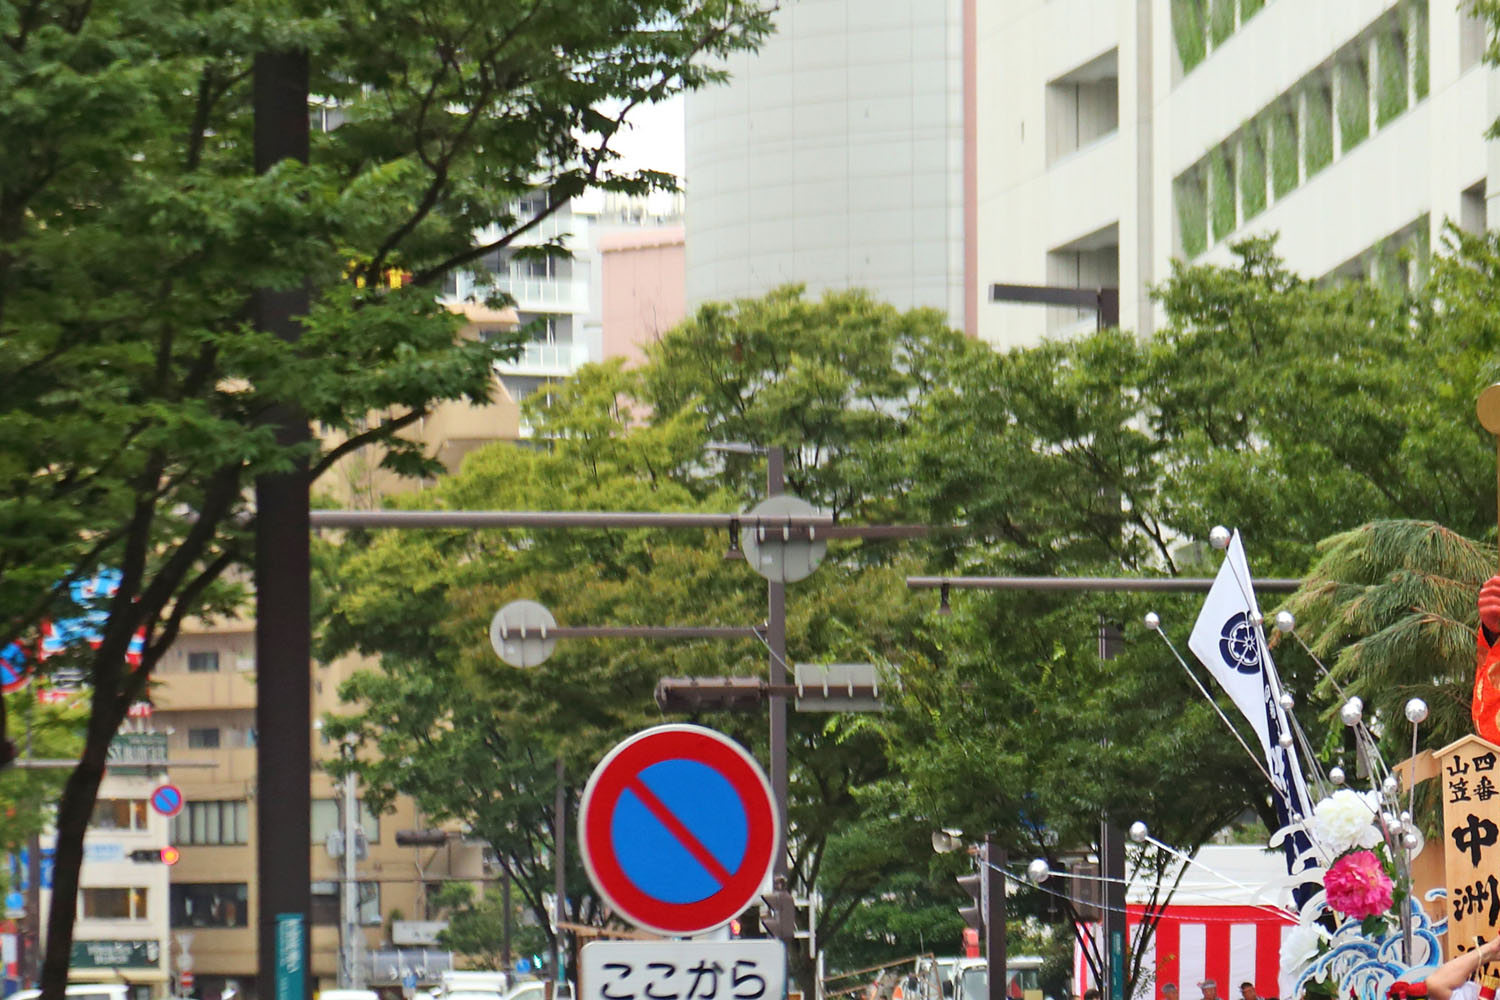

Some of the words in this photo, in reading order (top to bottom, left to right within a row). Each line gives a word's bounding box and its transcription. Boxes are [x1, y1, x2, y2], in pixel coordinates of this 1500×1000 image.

[1447, 754, 1473, 803] 山笠
[1472, 752, 1500, 802] 四番
[600, 959, 766, 1000] ここから
